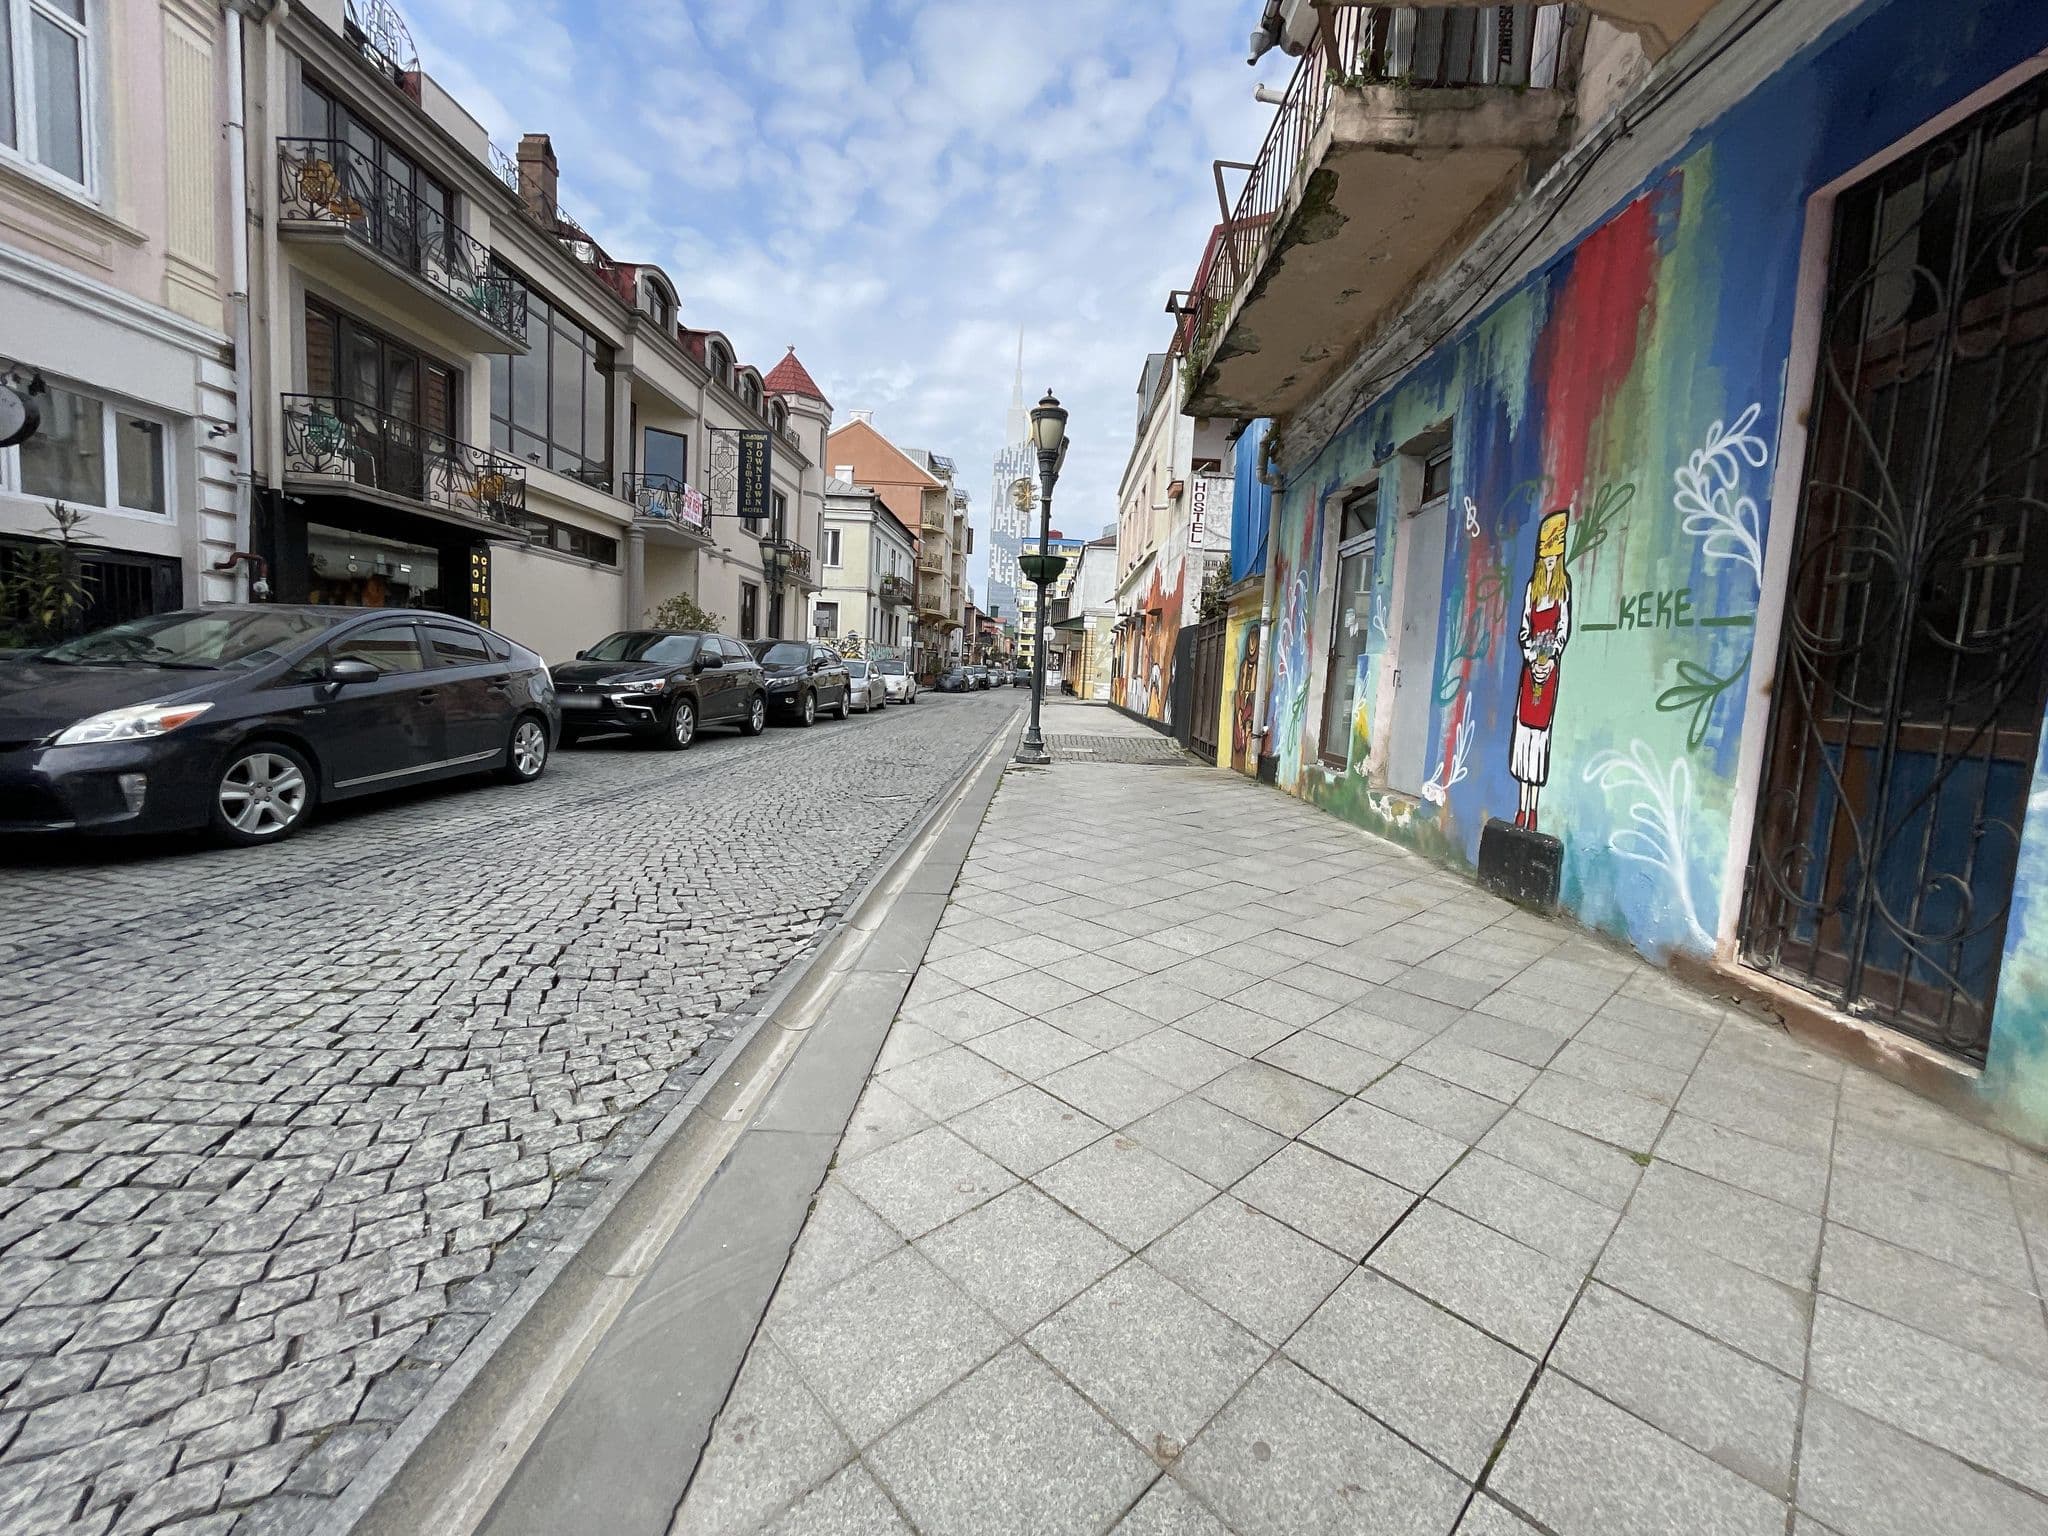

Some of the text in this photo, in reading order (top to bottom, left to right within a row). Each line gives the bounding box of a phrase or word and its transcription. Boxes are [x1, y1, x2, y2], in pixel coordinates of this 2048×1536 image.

[754, 441, 764, 506] DOWNTOWN
[1191, 481, 1206, 543] HOSTEL
[1619, 588, 1694, 630] KEKE
